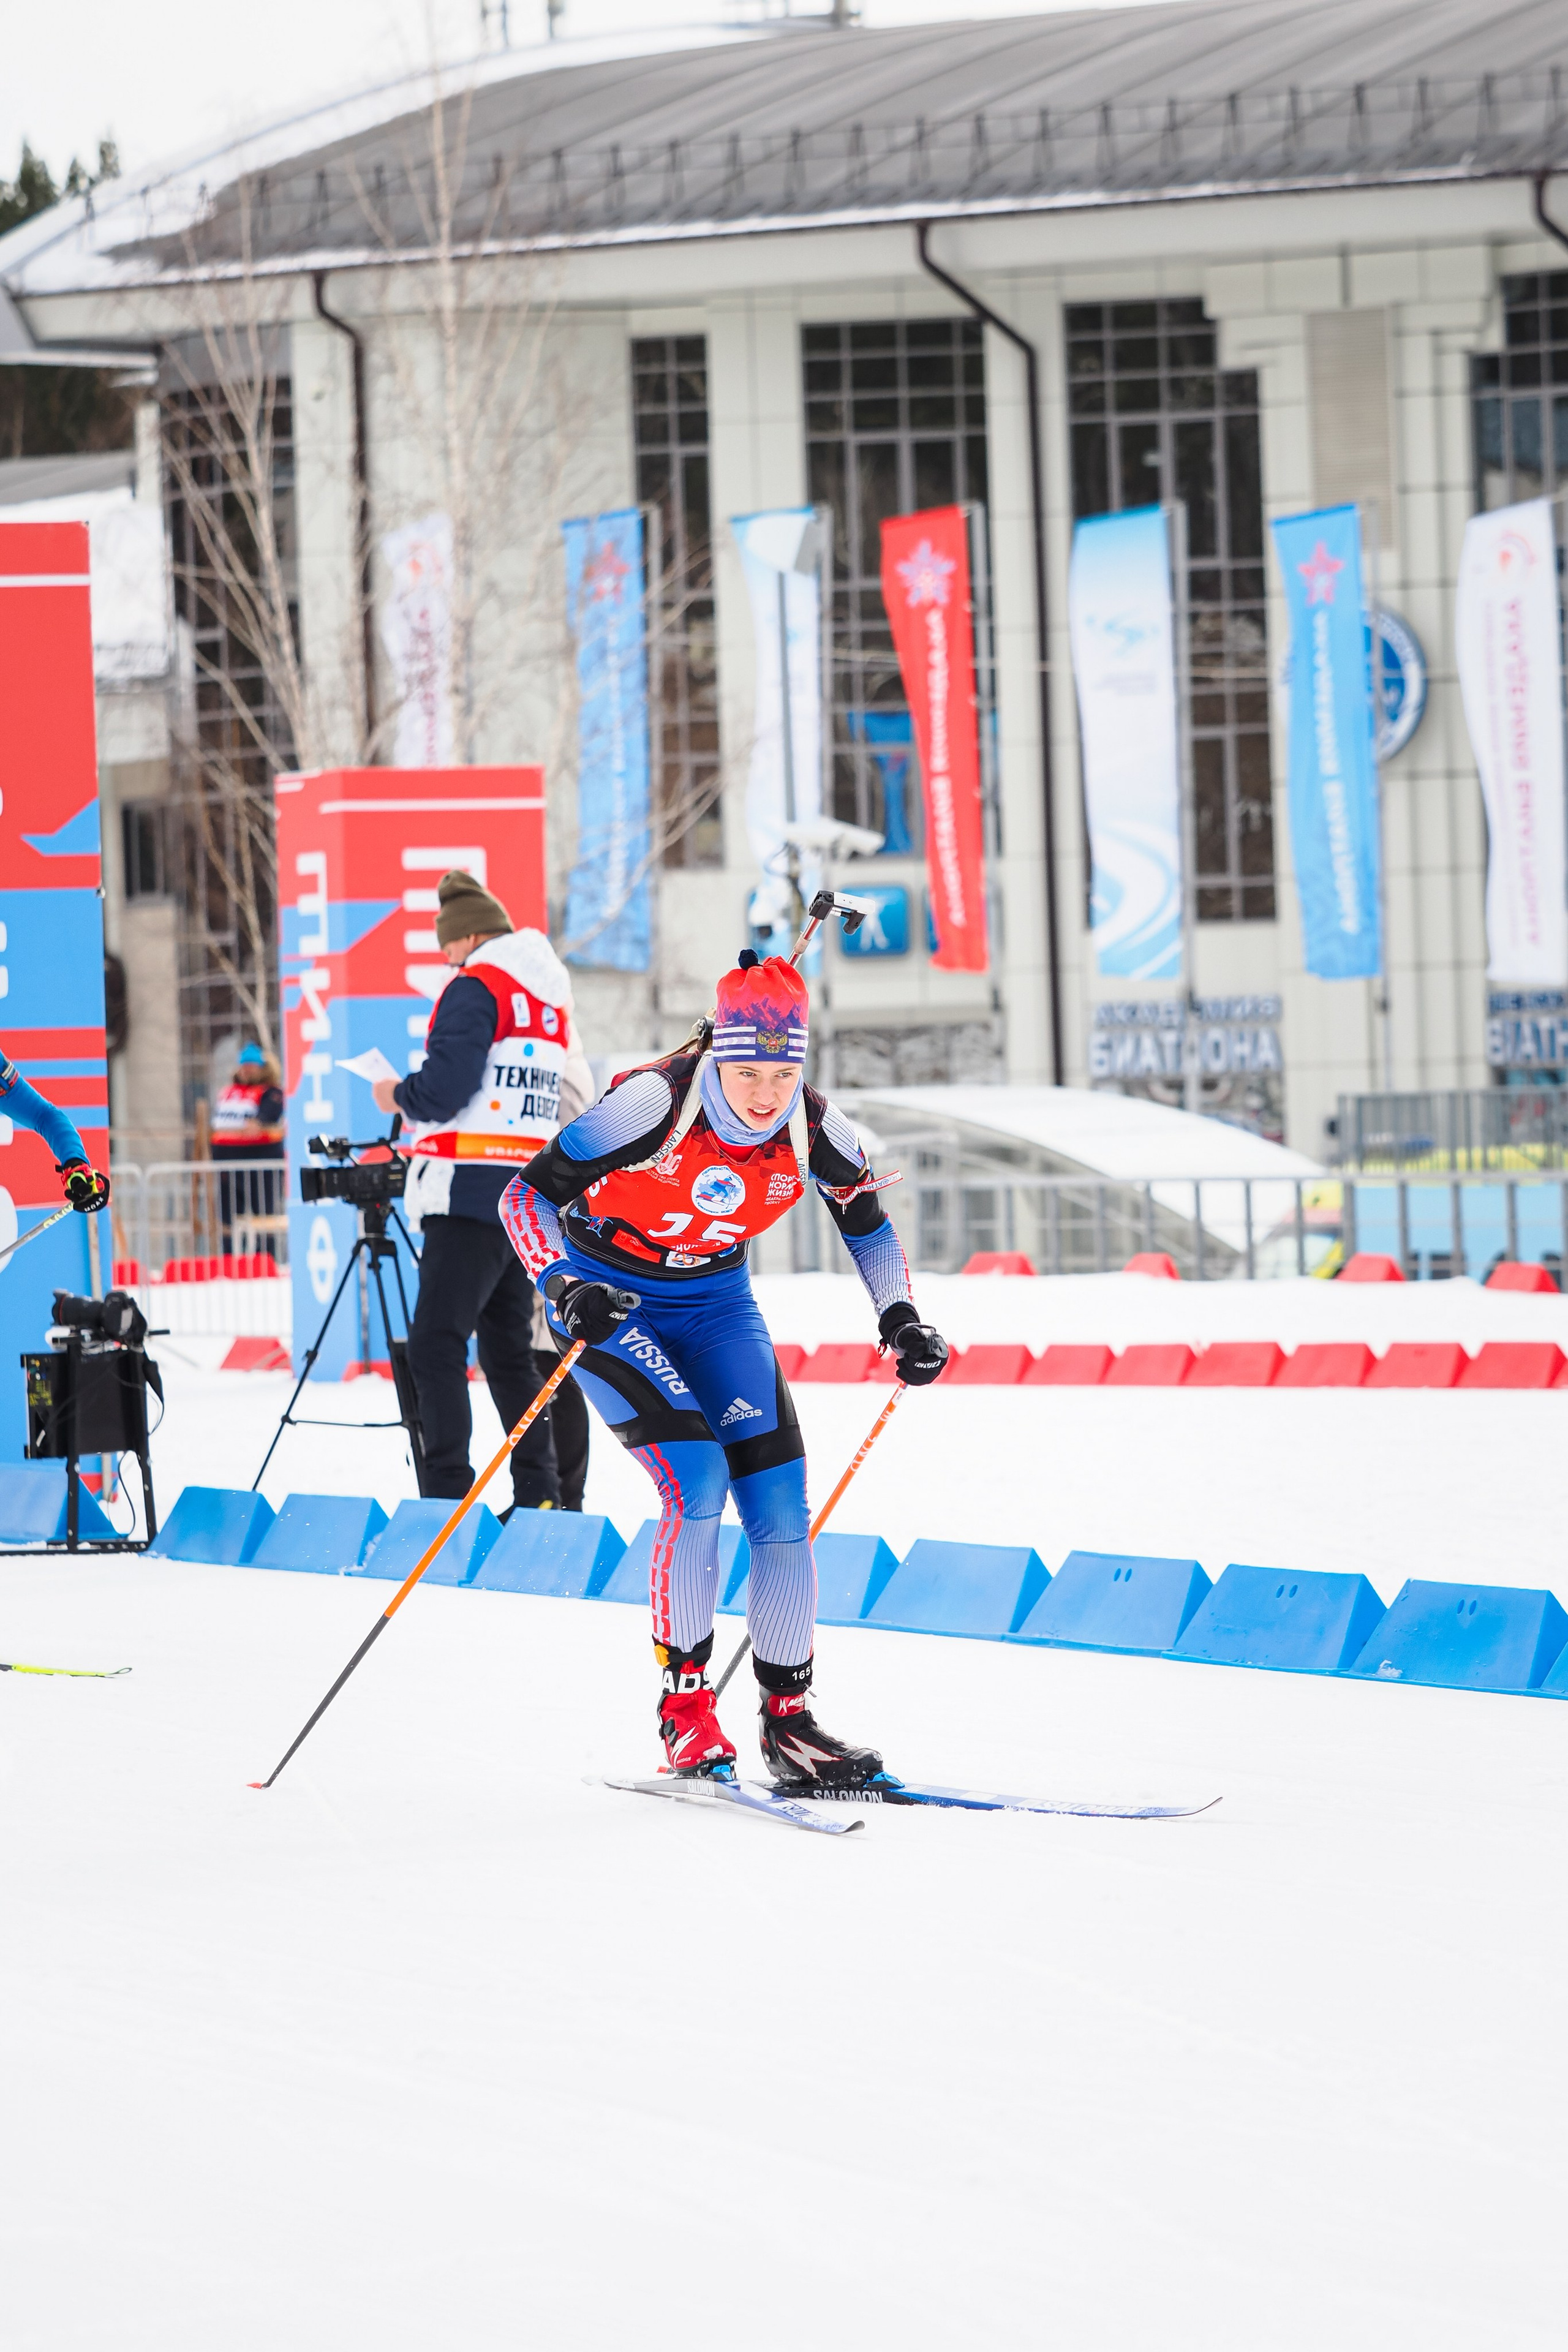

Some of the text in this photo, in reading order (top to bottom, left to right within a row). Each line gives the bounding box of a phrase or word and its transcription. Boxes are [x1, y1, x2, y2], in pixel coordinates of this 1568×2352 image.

[1088, 1025, 1285, 1076] БИАТОНА
[296, 851, 337, 1305] ФНИШ
[650, 1129, 682, 1164] LARSEN
[796, 1157, 807, 1186] LARSEN
[647, 1212, 747, 1244] 15
[619, 1327, 690, 1395] RUSSIA
[720, 1408, 763, 1427] adidas
[791, 1665, 811, 1681] 165
[687, 1780, 715, 1797] SALOMON
[813, 1789, 883, 1804] SALOMON
